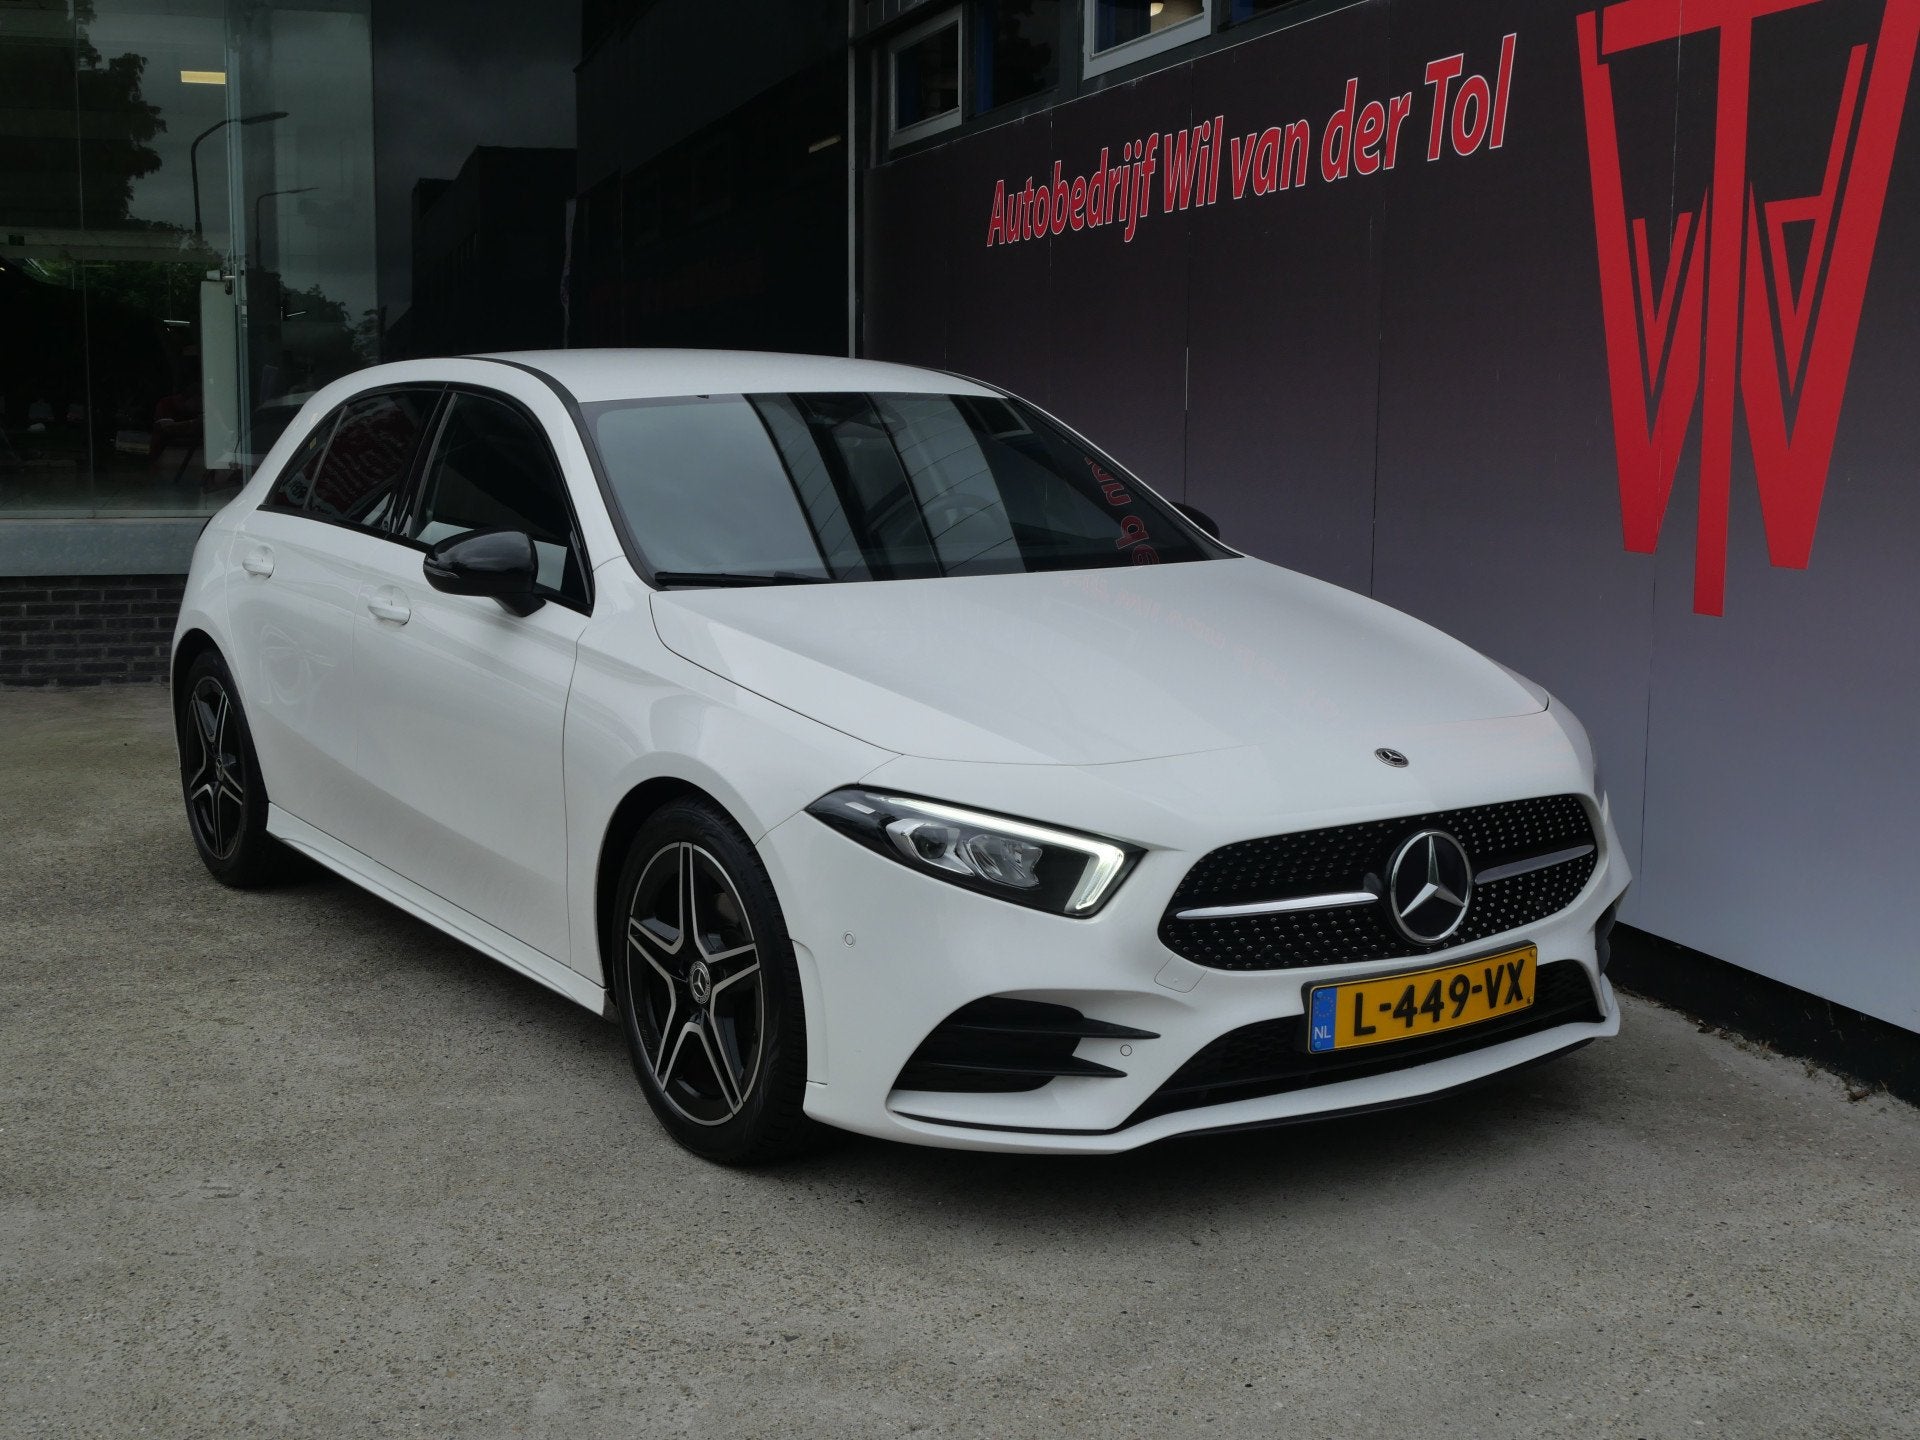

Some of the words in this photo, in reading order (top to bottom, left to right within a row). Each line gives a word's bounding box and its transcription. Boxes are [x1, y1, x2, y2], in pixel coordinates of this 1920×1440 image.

[986, 132, 1159, 247] Autobedrijf
[1162, 115, 1224, 213] Wil
[1229, 119, 1310, 200] van
[1320, 77, 1412, 183] der
[1424, 33, 1517, 161] Tol
[1314, 1025, 1332, 1040] NL
[1353, 958, 1525, 1037] L-449-VX
